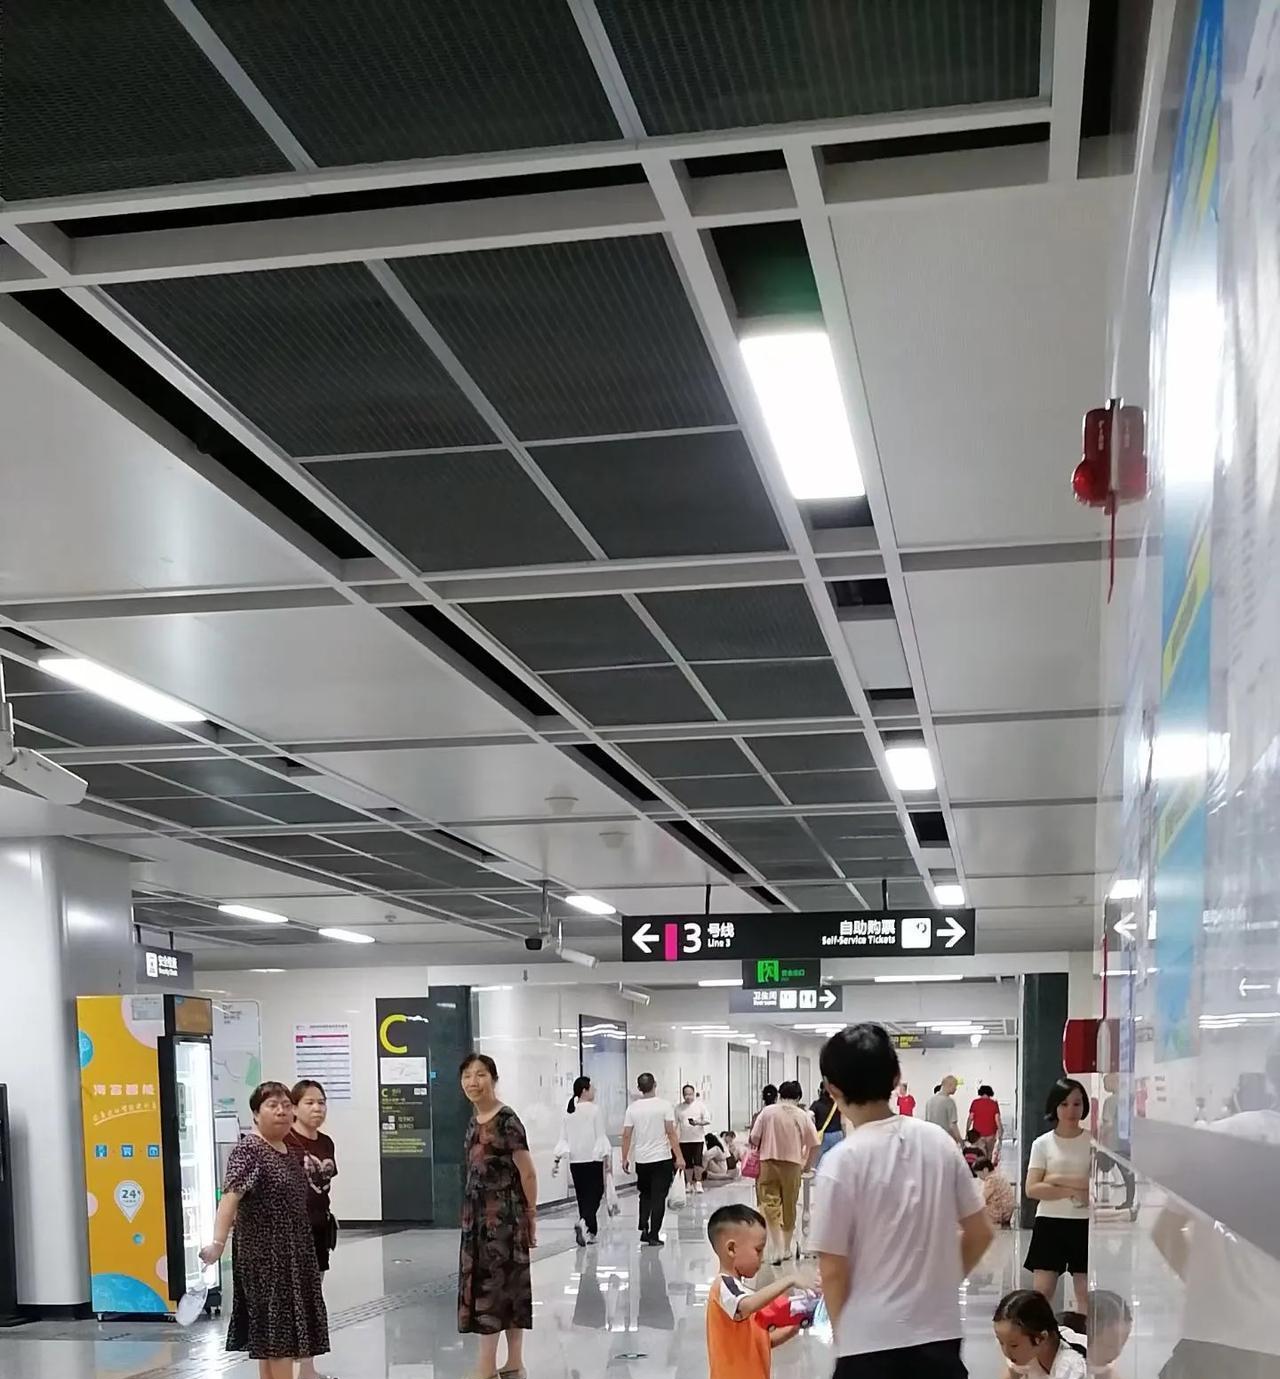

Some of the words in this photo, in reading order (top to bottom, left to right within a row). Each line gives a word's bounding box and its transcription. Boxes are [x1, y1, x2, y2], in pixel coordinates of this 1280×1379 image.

[840, 919, 896, 935] 自助购票
[682, 922, 702, 954] 3
[707, 922, 735, 938] 号线
[707, 938, 724, 948] Line
[821, 935, 867, 946] Self-Service
[867, 934, 896, 945] Tickets
[380, 1014, 407, 1054] C
